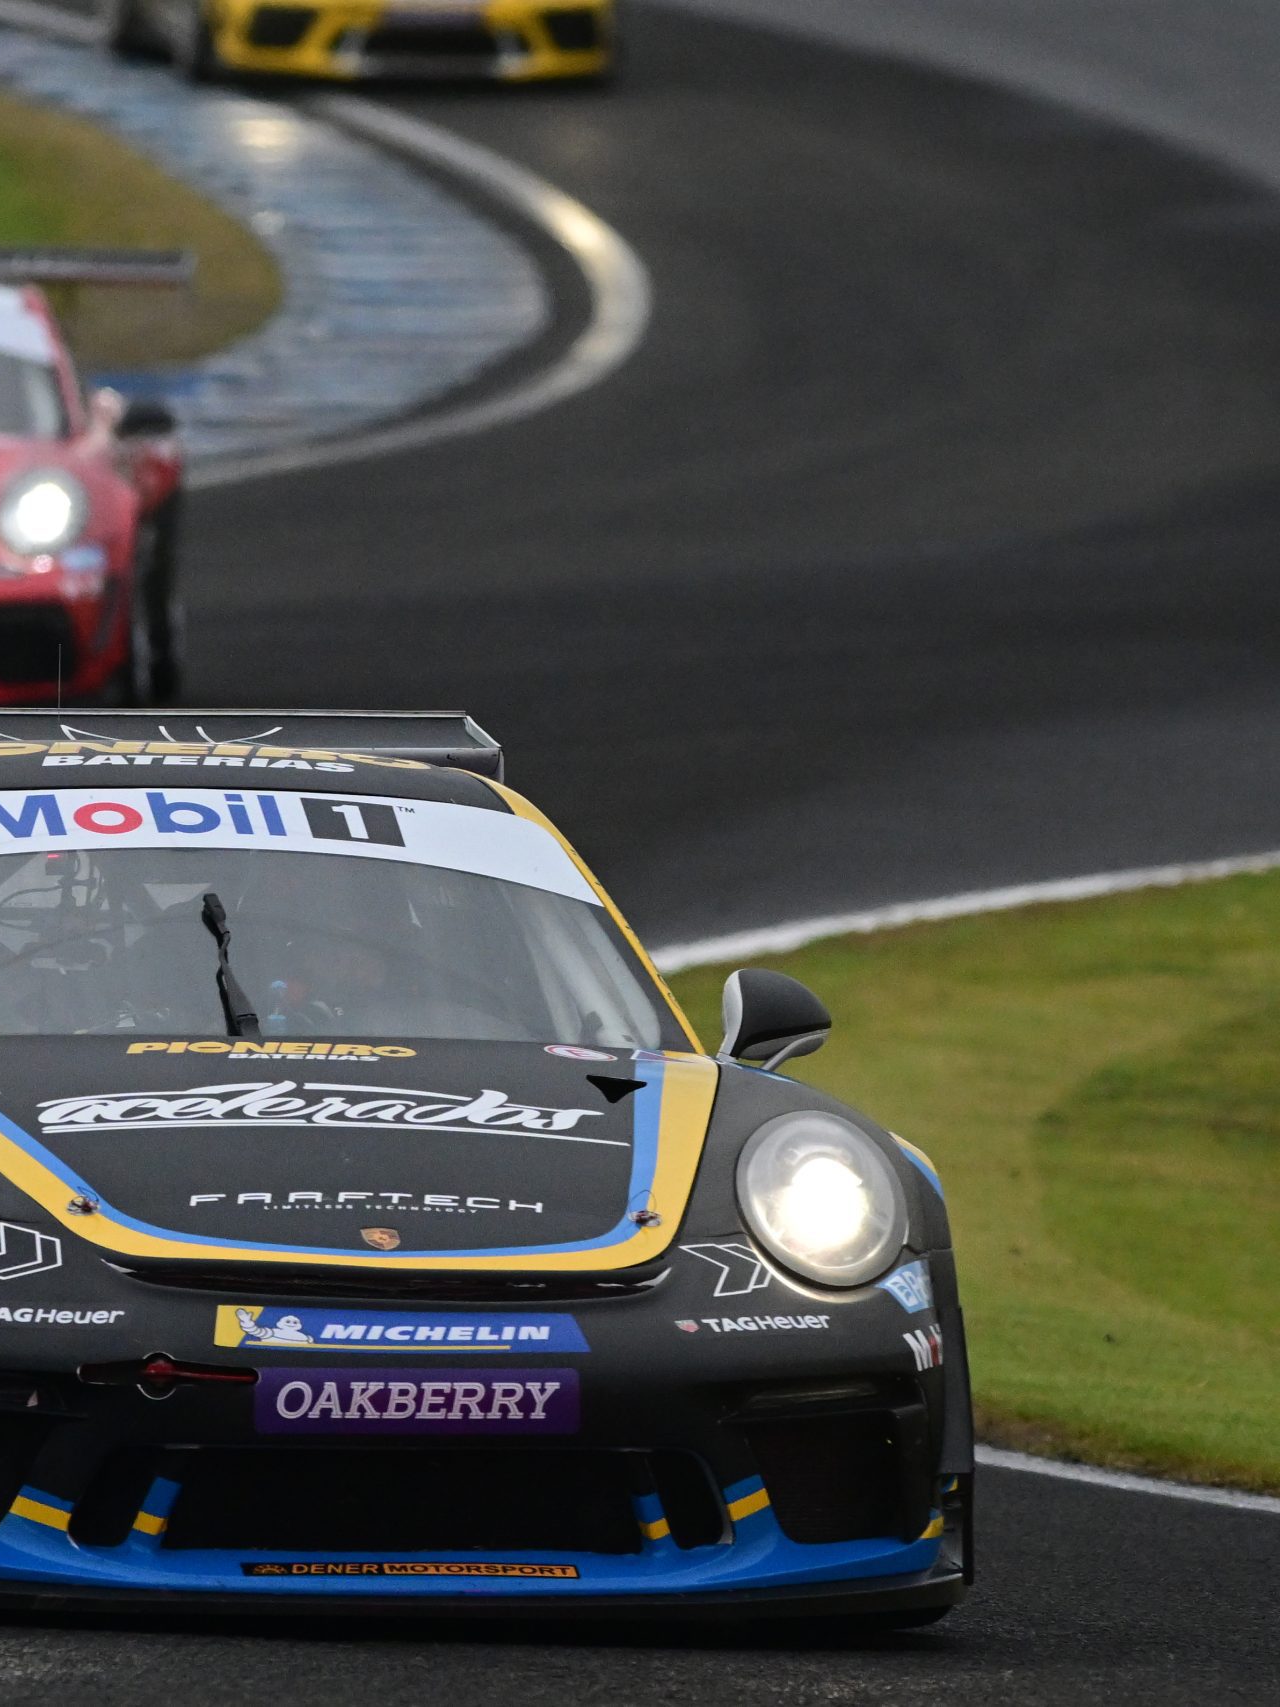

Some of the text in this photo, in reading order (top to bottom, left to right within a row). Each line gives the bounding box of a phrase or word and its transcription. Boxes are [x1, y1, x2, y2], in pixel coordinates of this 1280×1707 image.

[42, 754, 355, 773] BATERIAS
[331, 804, 370, 840] 1
[126, 1041, 417, 1059] PIONEIRO
[227, 1052, 381, 1063] BATERIAS
[35, 1079, 606, 1132] acelerados
[365, 1204, 479, 1214] TECHNOLOGY
[320, 1323, 551, 1342] MICHELIN
[276, 1381, 561, 1421] OAKBERRY
[292, 1563, 572, 1577] DENER MOTORSPORT
